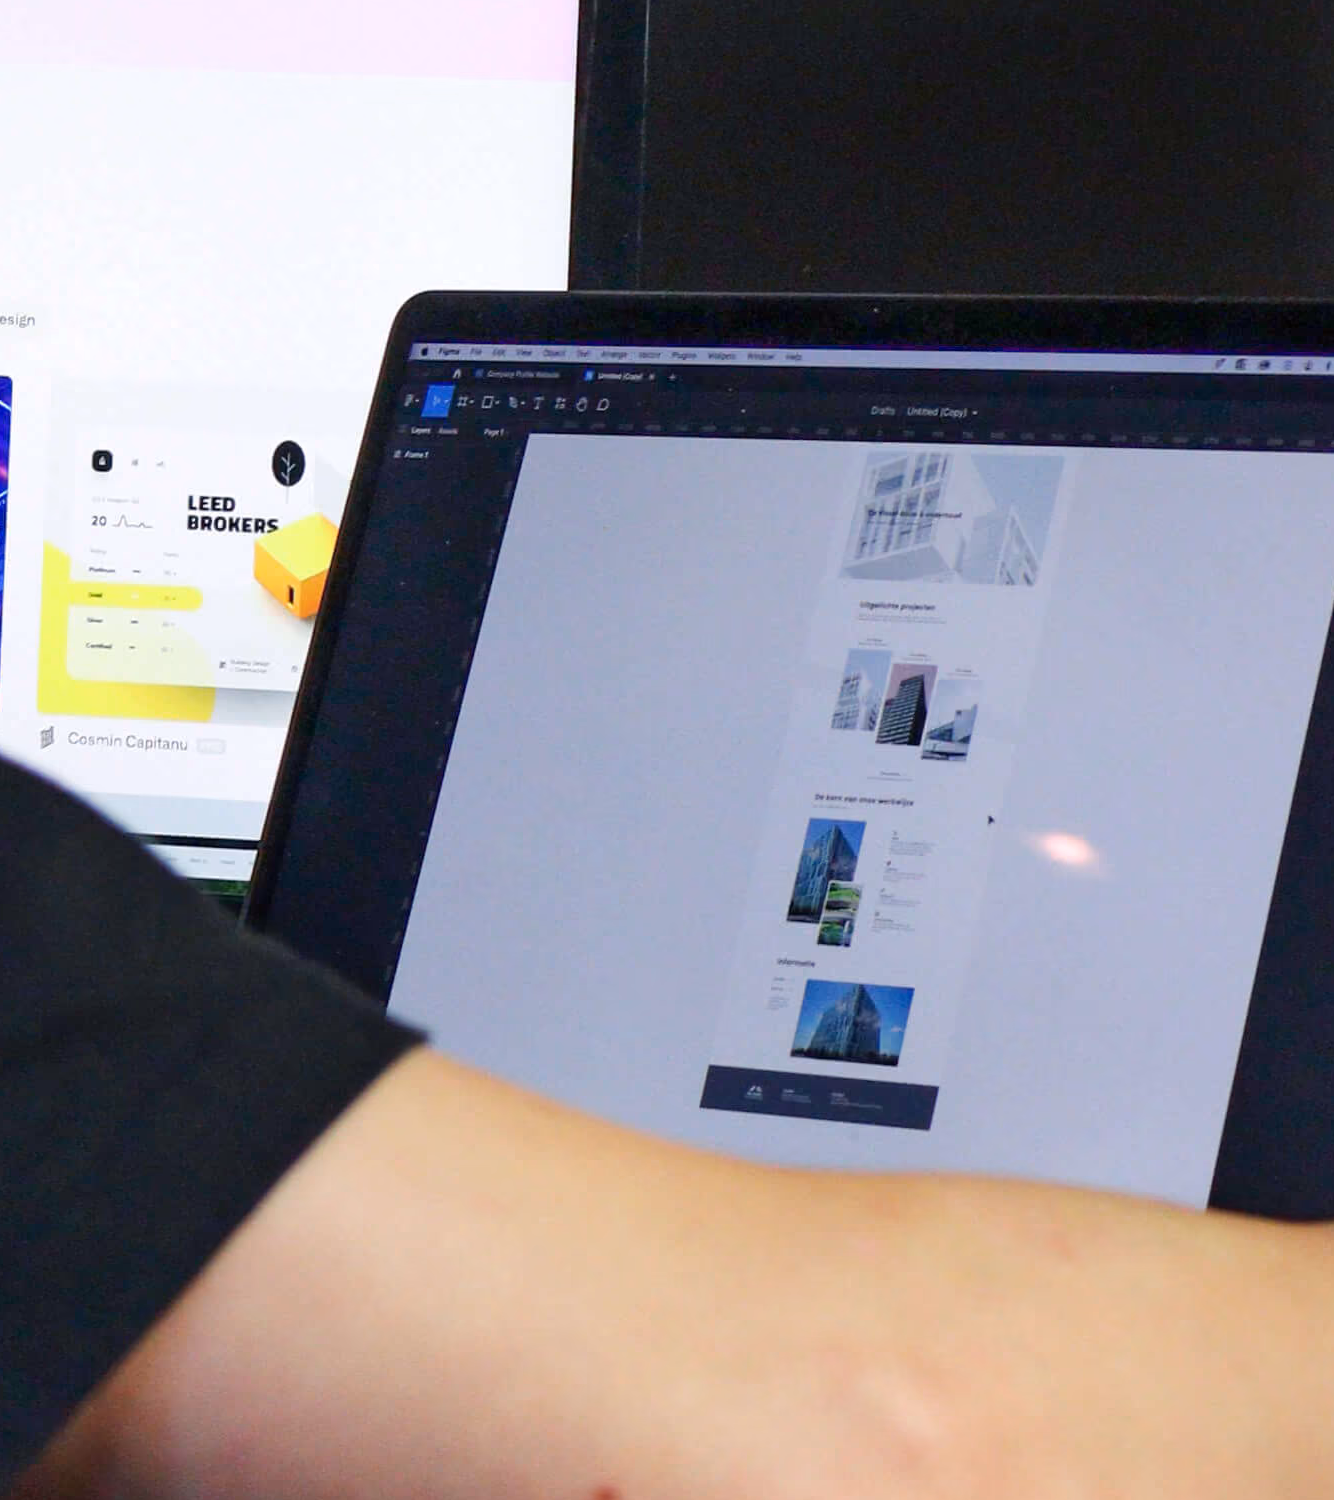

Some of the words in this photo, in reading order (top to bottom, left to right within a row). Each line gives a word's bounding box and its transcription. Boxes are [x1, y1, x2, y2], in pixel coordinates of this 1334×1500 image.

[188, 494, 236, 513] LEED
[91, 515, 108, 527] 20
[187, 514, 280, 534] BROKERS
[67, 731, 121, 748] Cosmin
[125, 734, 188, 751] Capitanu
